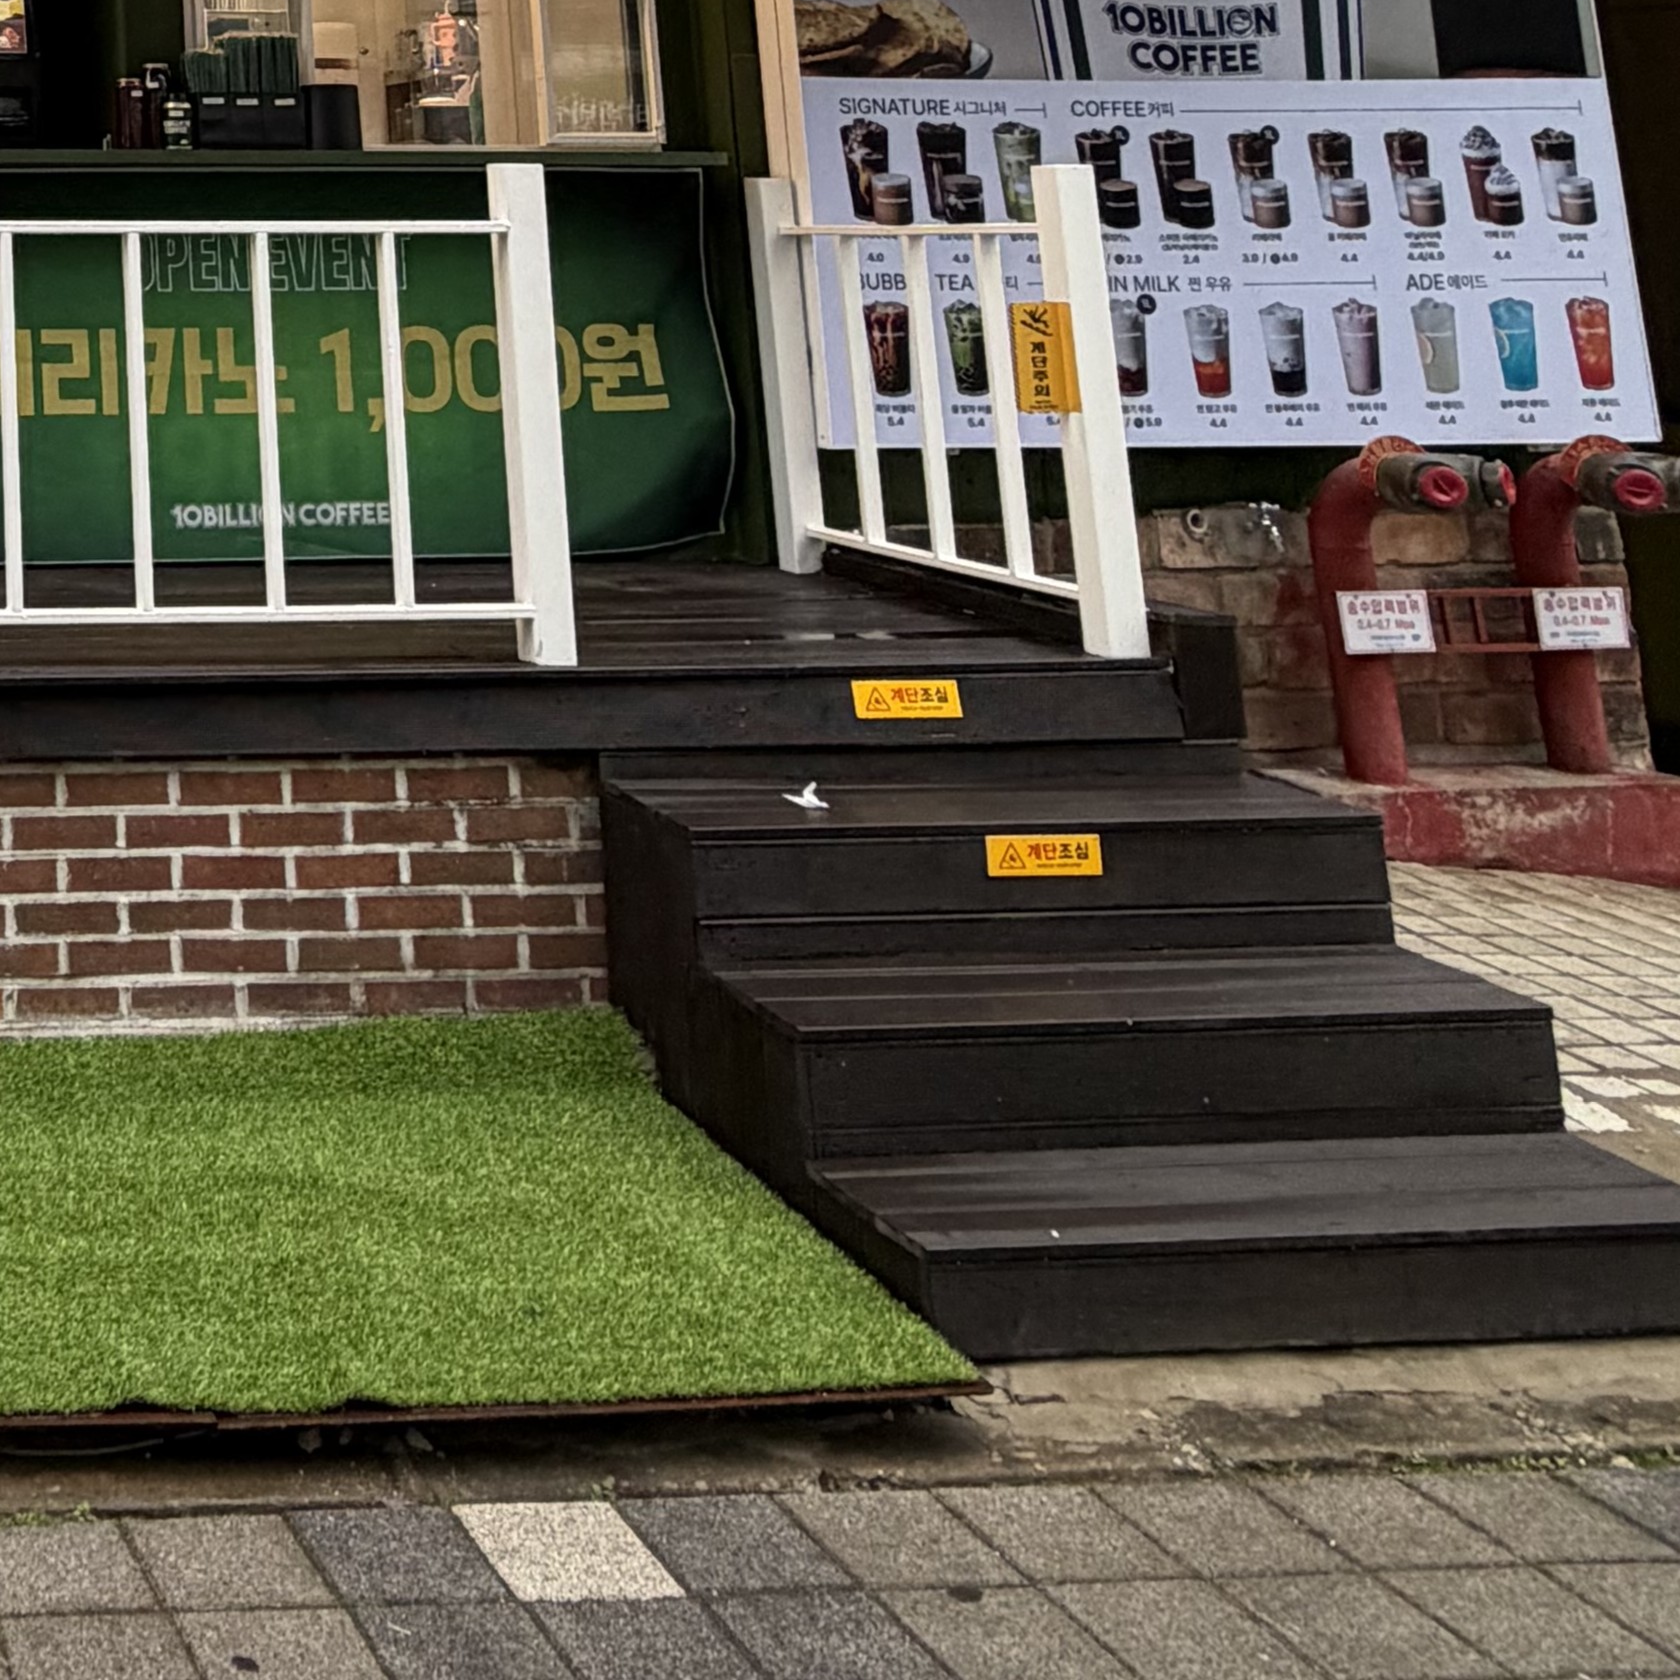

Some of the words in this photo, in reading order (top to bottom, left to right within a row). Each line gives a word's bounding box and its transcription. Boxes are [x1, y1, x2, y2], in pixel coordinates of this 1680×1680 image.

[1102, 0, 1280, 37] 10BILLION
[1128, 39, 1263, 75] COFFEE
[839, 97, 951, 116] SIGNATURE
[953, 100, 1006, 117] 시그니처
[1070, 100, 1146, 117] COFFEE
[1148, 101, 1174, 118] 커피
[934, 274, 974, 291] TEA
[1134, 275, 1181, 292] MILK
[1206, 276, 1232, 292] 우유
[1406, 273, 1446, 291] ADE
[1447, 274, 1488, 290] 에이드
[1030, 341, 1050, 398] 계단주의
[171, 502, 296, 529] 10BILLIN
[298, 502, 391, 526] COFFEE
[891, 687, 949, 704] 계단조심
[1028, 842, 1089, 860] 계단조심
